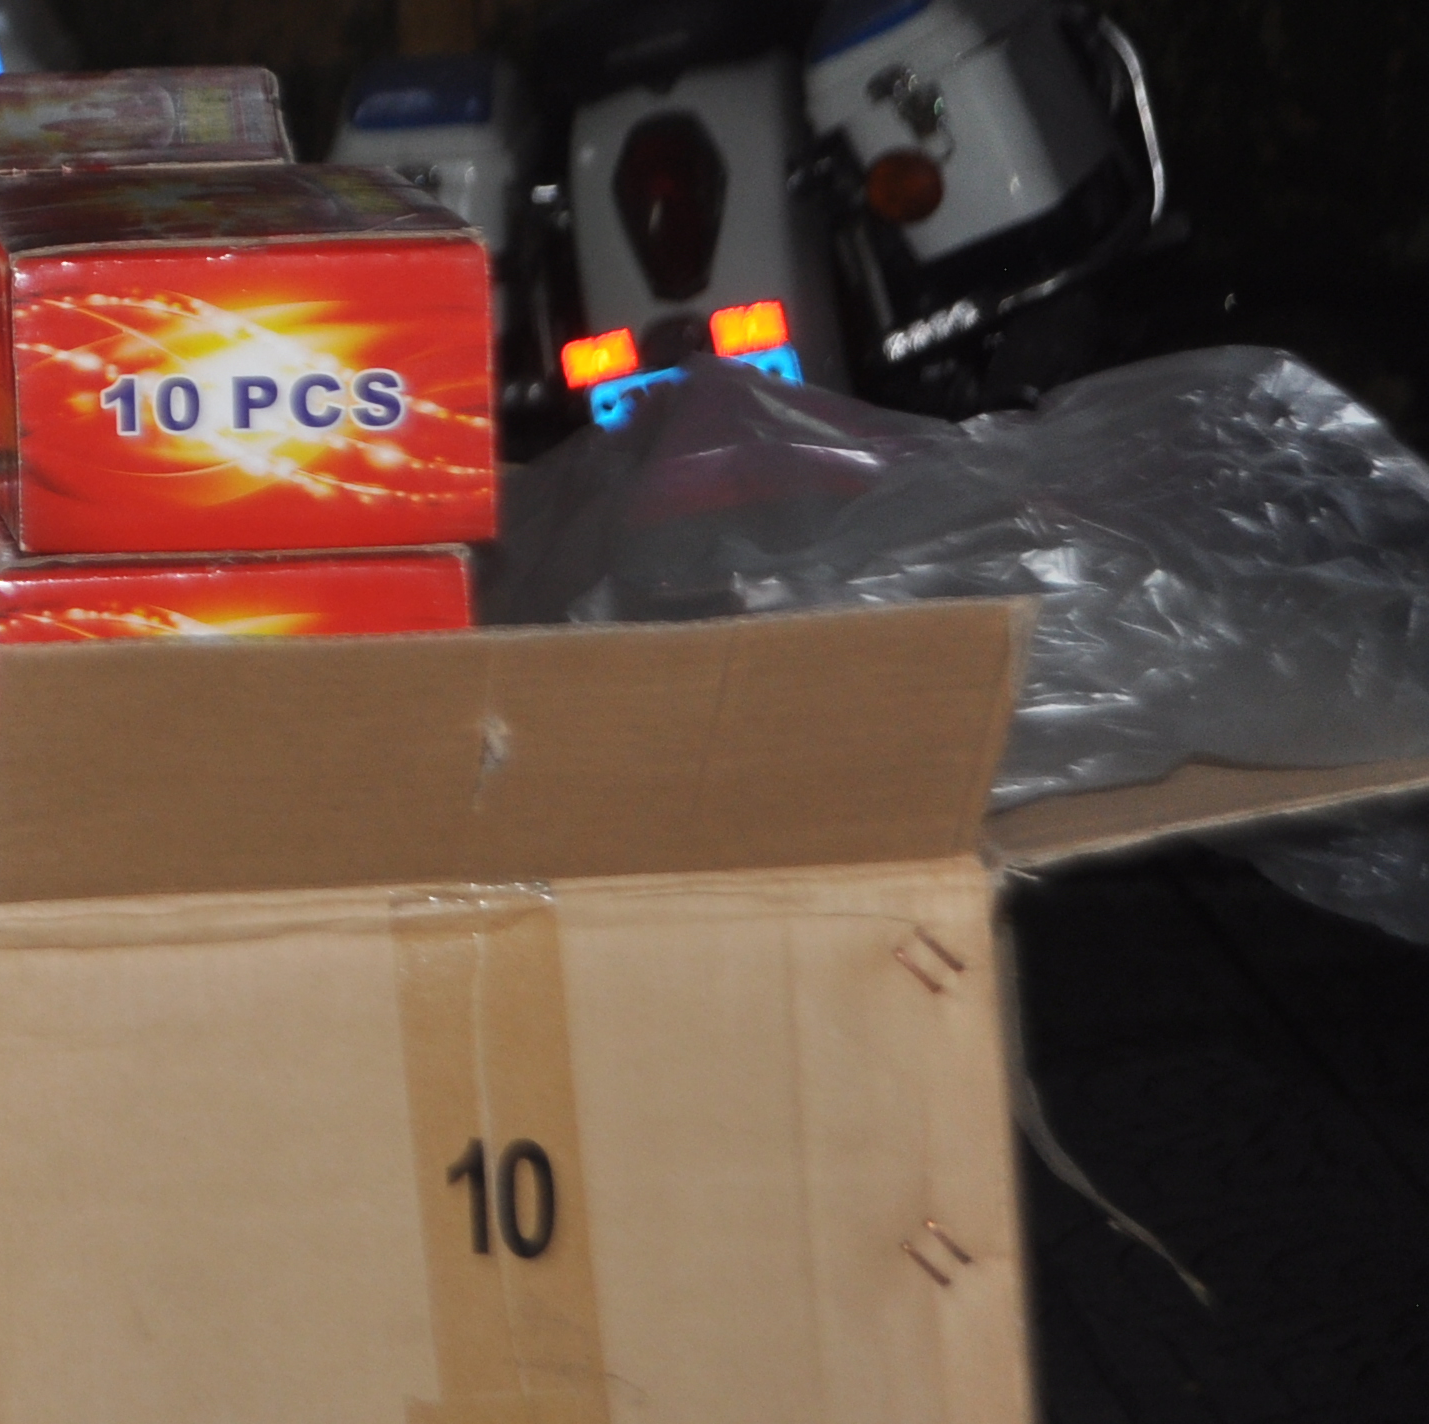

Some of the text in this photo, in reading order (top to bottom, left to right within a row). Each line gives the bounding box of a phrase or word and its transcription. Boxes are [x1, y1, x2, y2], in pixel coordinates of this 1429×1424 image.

[102, 370, 403, 434] 10 PCS
[445, 1137, 555, 1259] 10
